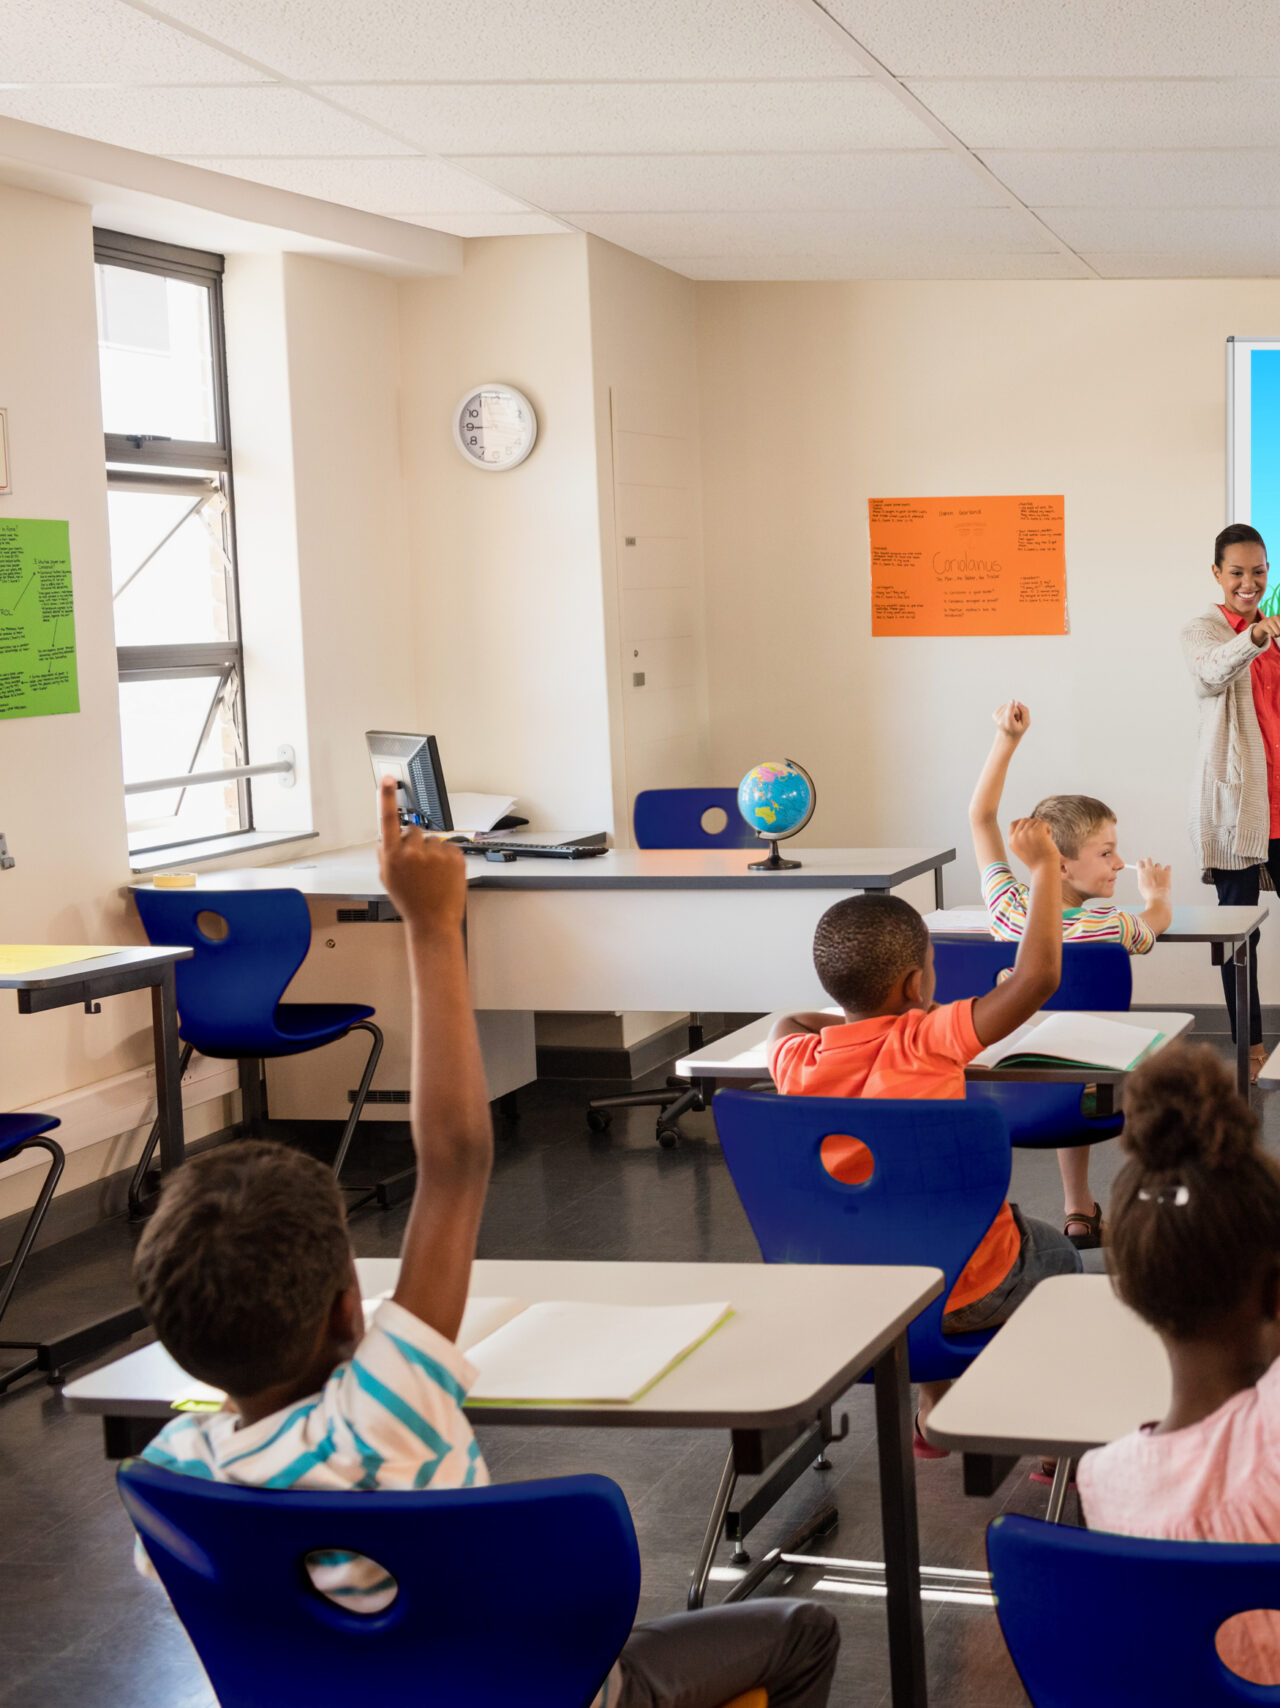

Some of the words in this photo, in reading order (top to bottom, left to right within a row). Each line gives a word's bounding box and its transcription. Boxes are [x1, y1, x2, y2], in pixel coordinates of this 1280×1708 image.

[467, 409, 479, 418] 10
[465, 422, 475, 432] 9
[469, 436, 478, 445] 8
[933, 551, 1002, 575] Coriolanus
